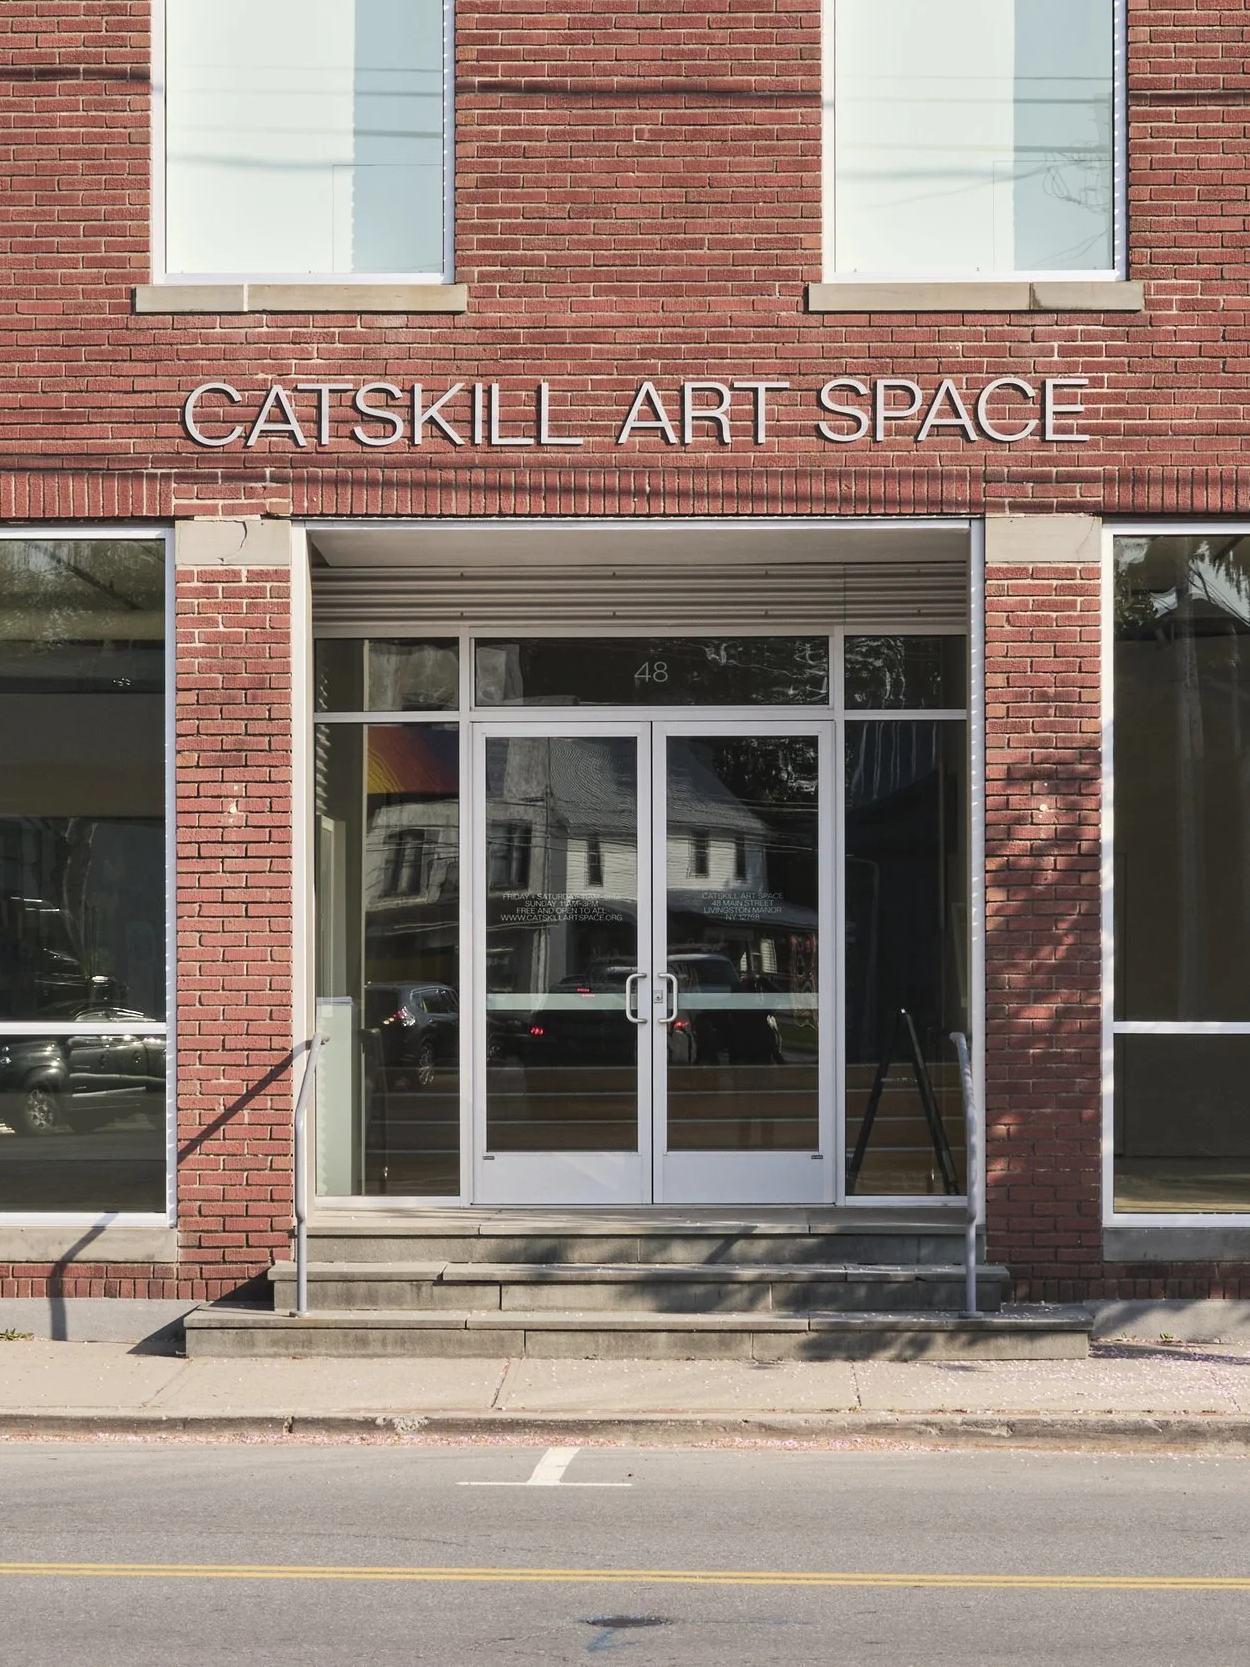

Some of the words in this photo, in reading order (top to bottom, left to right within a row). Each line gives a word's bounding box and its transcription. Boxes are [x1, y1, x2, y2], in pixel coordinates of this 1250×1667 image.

[183, 381, 583, 447] CATSKILL
[617, 381, 790, 445] ART
[819, 378, 1090, 443] SPACE
[634, 661, 668, 682] 48
